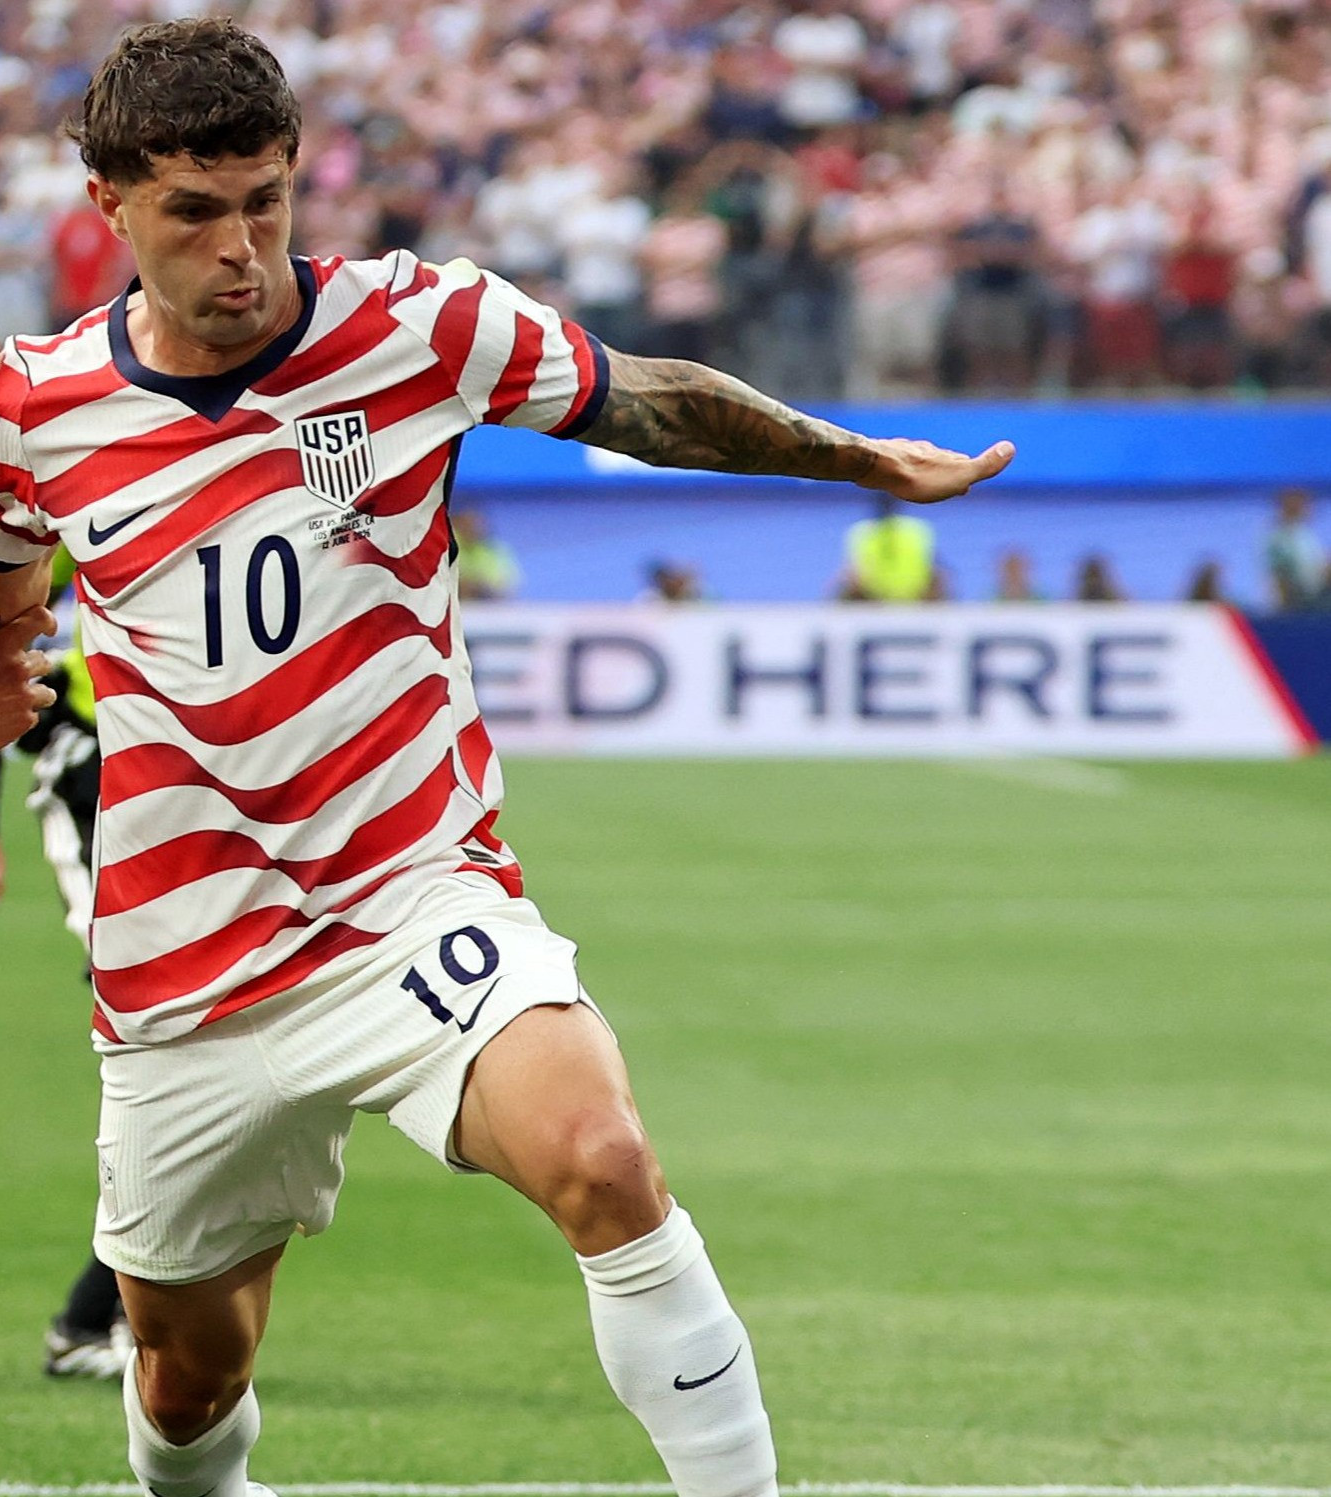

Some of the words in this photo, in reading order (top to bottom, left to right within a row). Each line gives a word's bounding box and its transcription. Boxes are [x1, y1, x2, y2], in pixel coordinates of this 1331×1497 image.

[301, 416, 363, 455] USA
[308, 520, 324, 530] USA
[314, 530, 328, 541] LOS
[332, 533, 350, 547] JUNE
[196, 534, 301, 668] 10
[724, 632, 1176, 722] HERE
[400, 925, 500, 1025] 10
